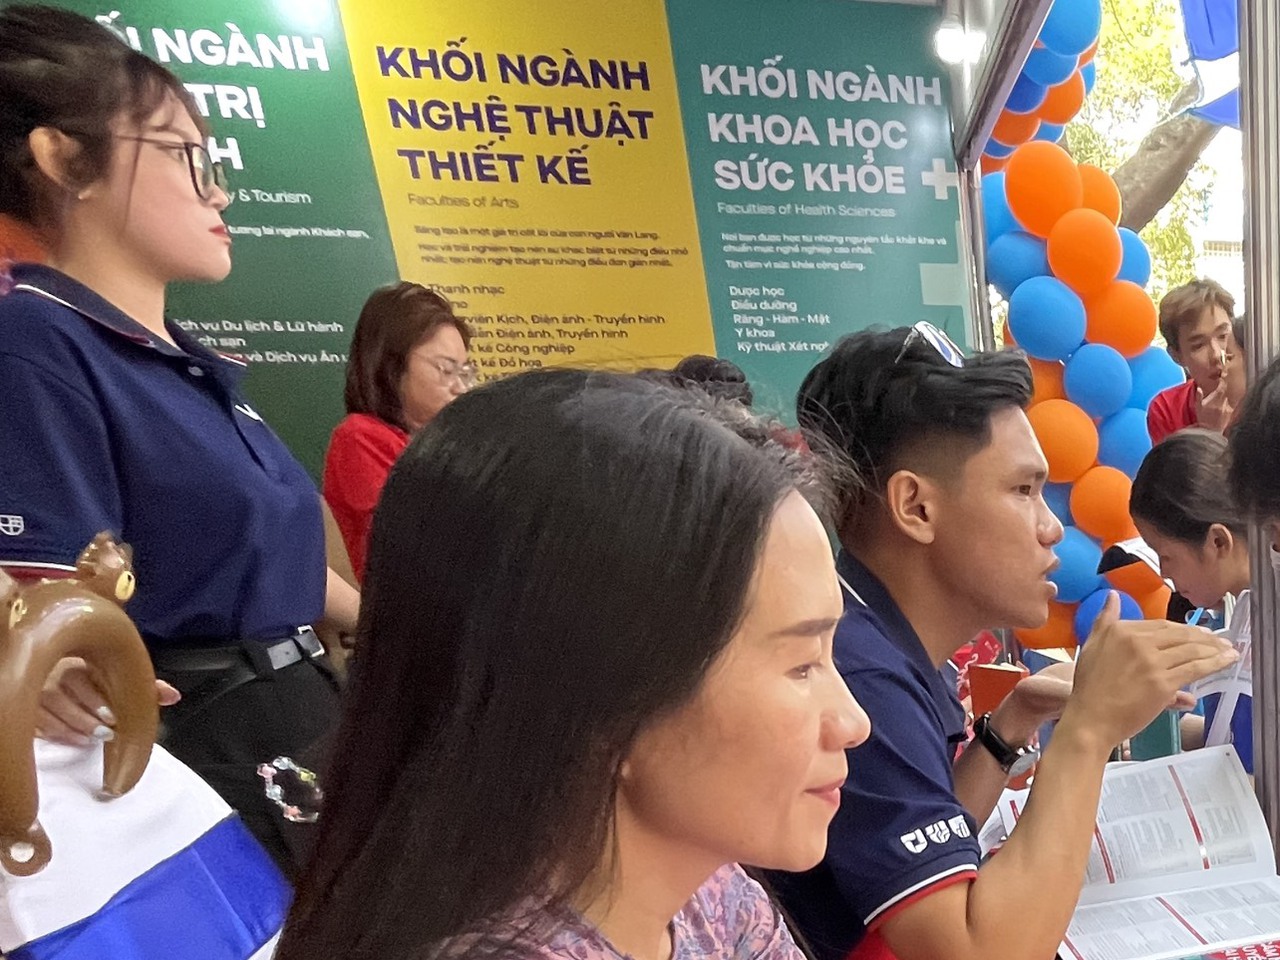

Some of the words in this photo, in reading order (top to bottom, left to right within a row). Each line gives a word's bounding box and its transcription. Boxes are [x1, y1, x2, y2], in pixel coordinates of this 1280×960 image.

[151, 20, 330, 71] NGÀNH
[376, 36, 487, 83] KHỐI
[496, 47, 651, 91] NGÀNH
[700, 54, 798, 99] KHỐI
[806, 64, 942, 106] NGÀNH
[183, 82, 267, 129] TRỊ
[386, 95, 512, 142] NGHỆ
[514, 101, 654, 147] THUẬT
[707, 112, 821, 146] KHOA
[826, 117, 908, 153] HỌC
[396, 140, 525, 184] THIẾT
[535, 144, 592, 186] KẾ
[714, 153, 795, 192] SỨC
[802, 151, 907, 194] KHỎE
[251, 189, 313, 204] Tourism
[407, 193, 471, 208] Faculties
[472, 195, 487, 208] of
[490, 196, 519, 209] Arts
[717, 202, 776, 215] Faculties
[778, 203, 792, 215] of
[794, 203, 837, 216] Health
[837, 204, 896, 218] Sciences
[734, 327, 743, 338] Y
[745, 327, 776, 338] khoa
